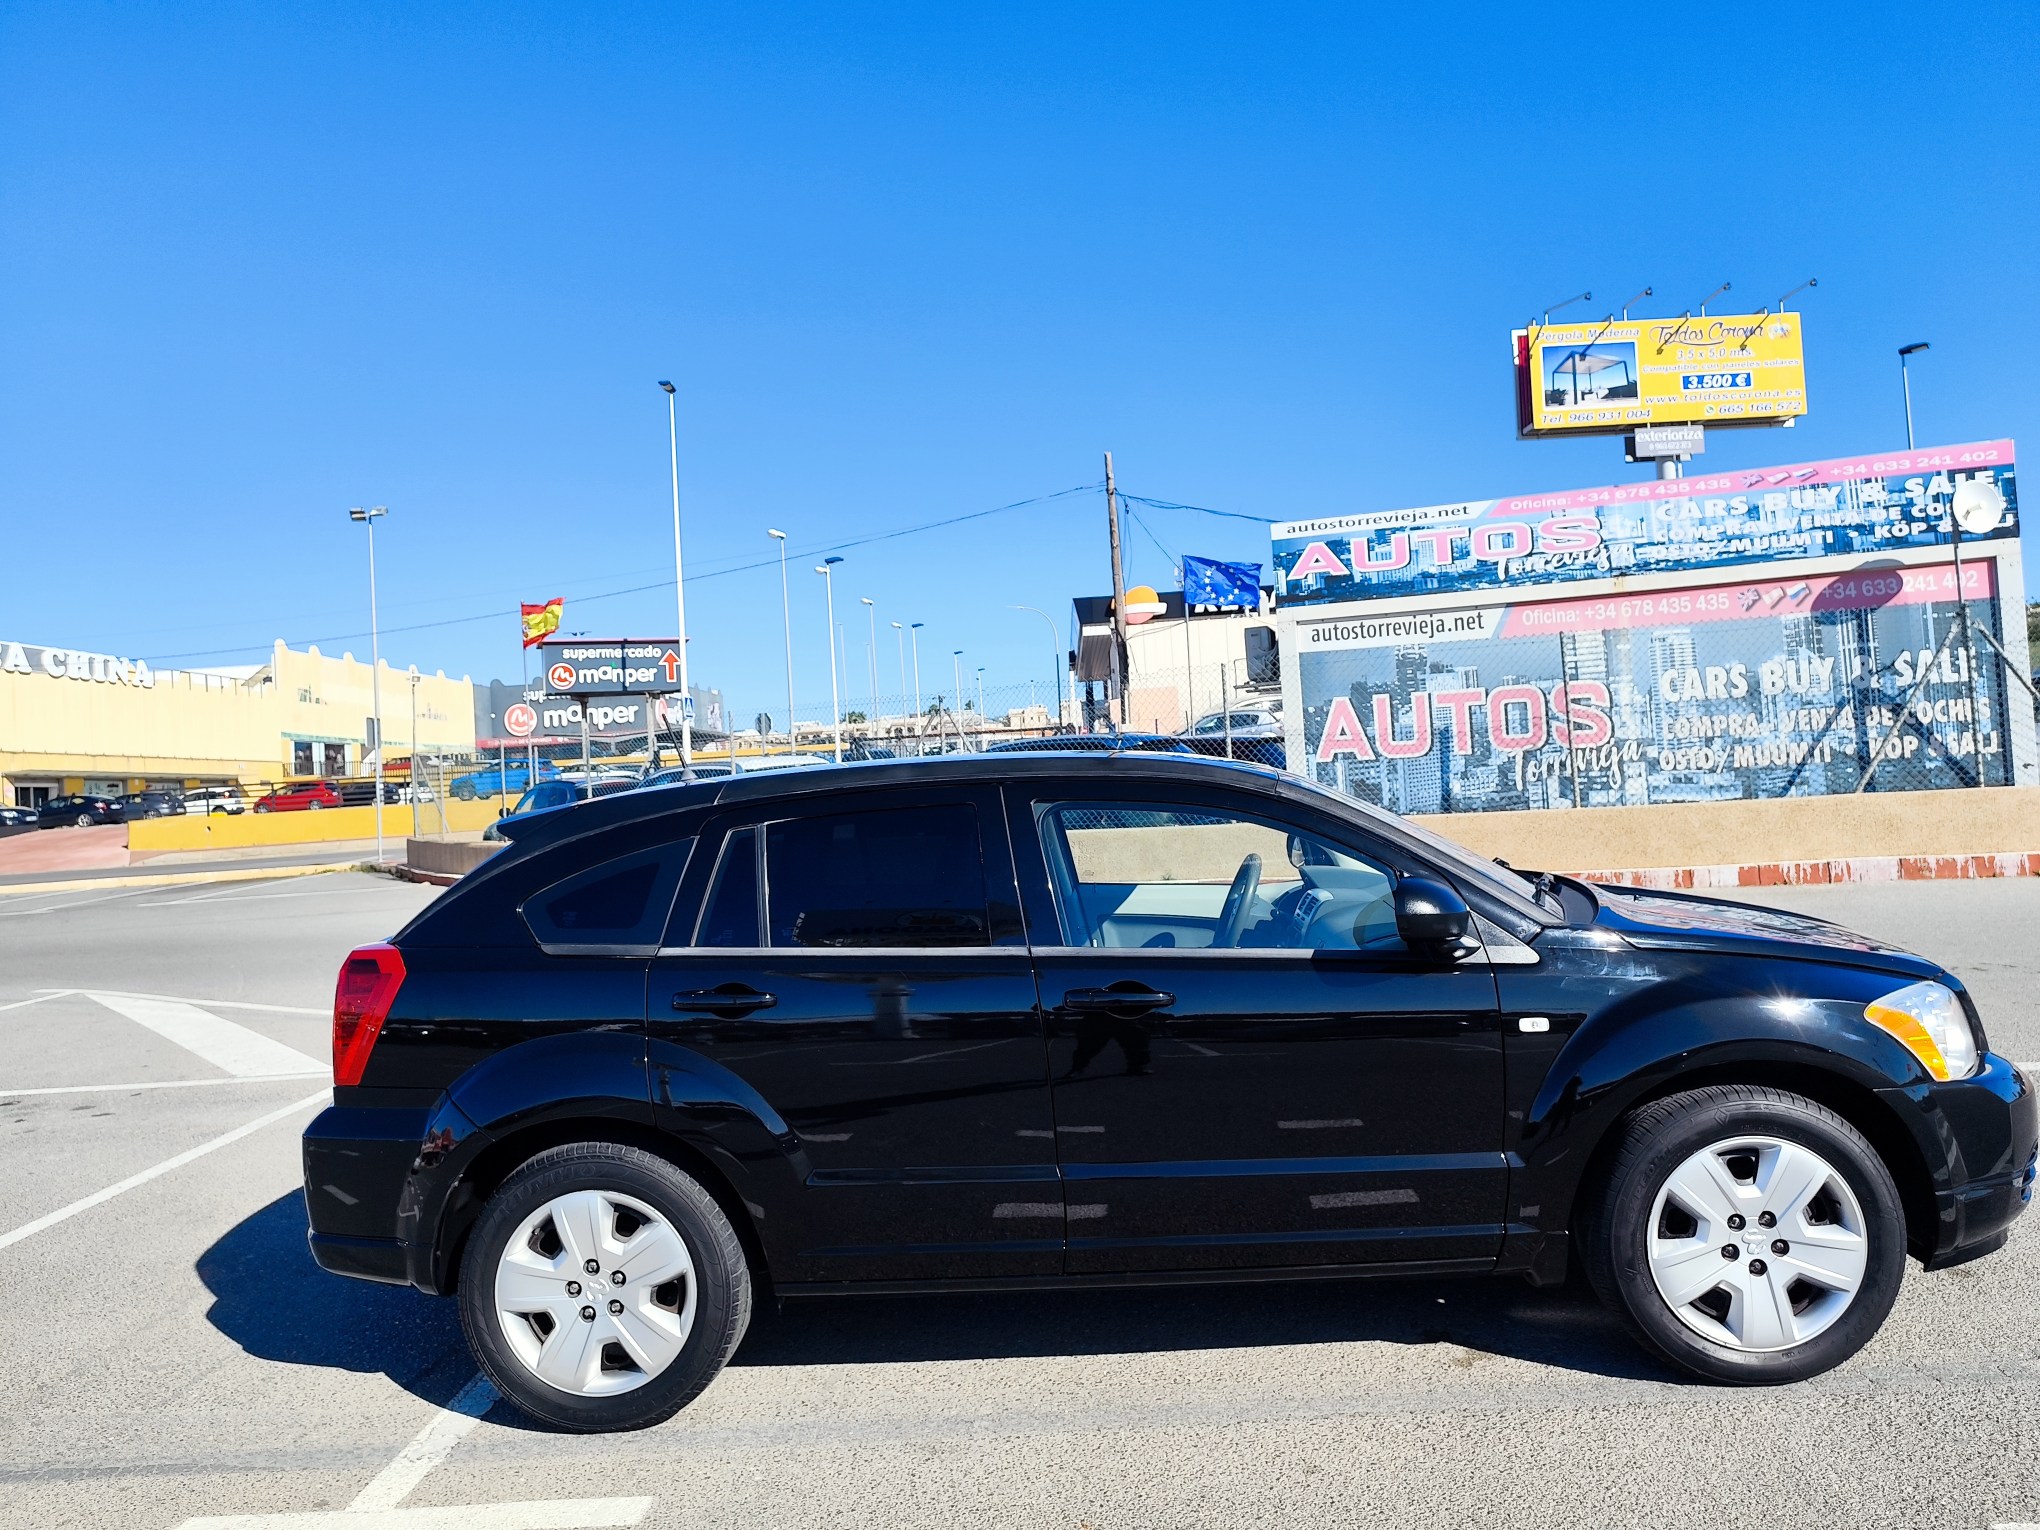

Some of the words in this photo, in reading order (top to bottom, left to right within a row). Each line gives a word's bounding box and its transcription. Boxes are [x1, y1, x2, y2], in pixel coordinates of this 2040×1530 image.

[1588, 329, 1640, 338] Moderna
[1649, 325, 1704, 344] Toldos
[1709, 322, 1764, 341] Corona
[1643, 364, 1698, 373] Compatible
[1723, 361, 1761, 370] paneles
[1764, 359, 1800, 367] solares
[1687, 375, 1732, 389] 3.500
[1735, 374, 1748, 387] €
[1569, 412, 1594, 423] 966
[1598, 411, 1621, 420] 931
[1626, 409, 1651, 419] 004
[1719, 405, 1744, 414] 665
[1750, 403, 1772, 412] 166
[1776, 401, 1801, 411] 572
[1635, 429, 1703, 443] exterioriza
[1287, 505, 1470, 534] autostorrevieja.net
[1510, 497, 1572, 511] Oficina:
[1578, 490, 1611, 504] +34
[1615, 486, 1650, 500] 678
[1654, 482, 1691, 496] 435
[1695, 478, 1731, 491] 435
[1829, 462, 1868, 477] +34
[1872, 458, 1912, 472] 633
[1917, 454, 1955, 468] 241
[1959, 450, 1999, 464] 402
[1655, 495, 1749, 522] CARS
[1764, 485, 1842, 512] BUY
[1655, 519, 1761, 544] COMPRA
[1784, 508, 1864, 530] VENTA
[1871, 507, 1902, 522] DE
[1874, 521, 1928, 539] KÖP
[1287, 515, 1604, 581] AUTOS
[1311, 611, 1485, 643] autostorrevieja.net
[1522, 608, 1580, 626] Oficina:
[1585, 602, 1617, 620] +34
[1621, 600, 1654, 618] 678
[1658, 596, 1692, 614] 435
[1696, 592, 1730, 611] 435
[1822, 582, 1857, 599] +34
[1861, 577, 1898, 597] 633
[1903, 574, 1938, 593] 241
[562, 644, 662, 661] supermercado
[42, 650, 153, 690] CHINA
[578, 665, 658, 687] manper
[1660, 663, 1749, 702] CARS
[1761, 656, 1835, 696] BUY
[543, 704, 639, 730] manper
[1316, 679, 1613, 763] AUTOS
[1664, 712, 1760, 741] COMPRA
[1783, 705, 1855, 733] VENTA
[1864, 704, 1894, 728] DE
